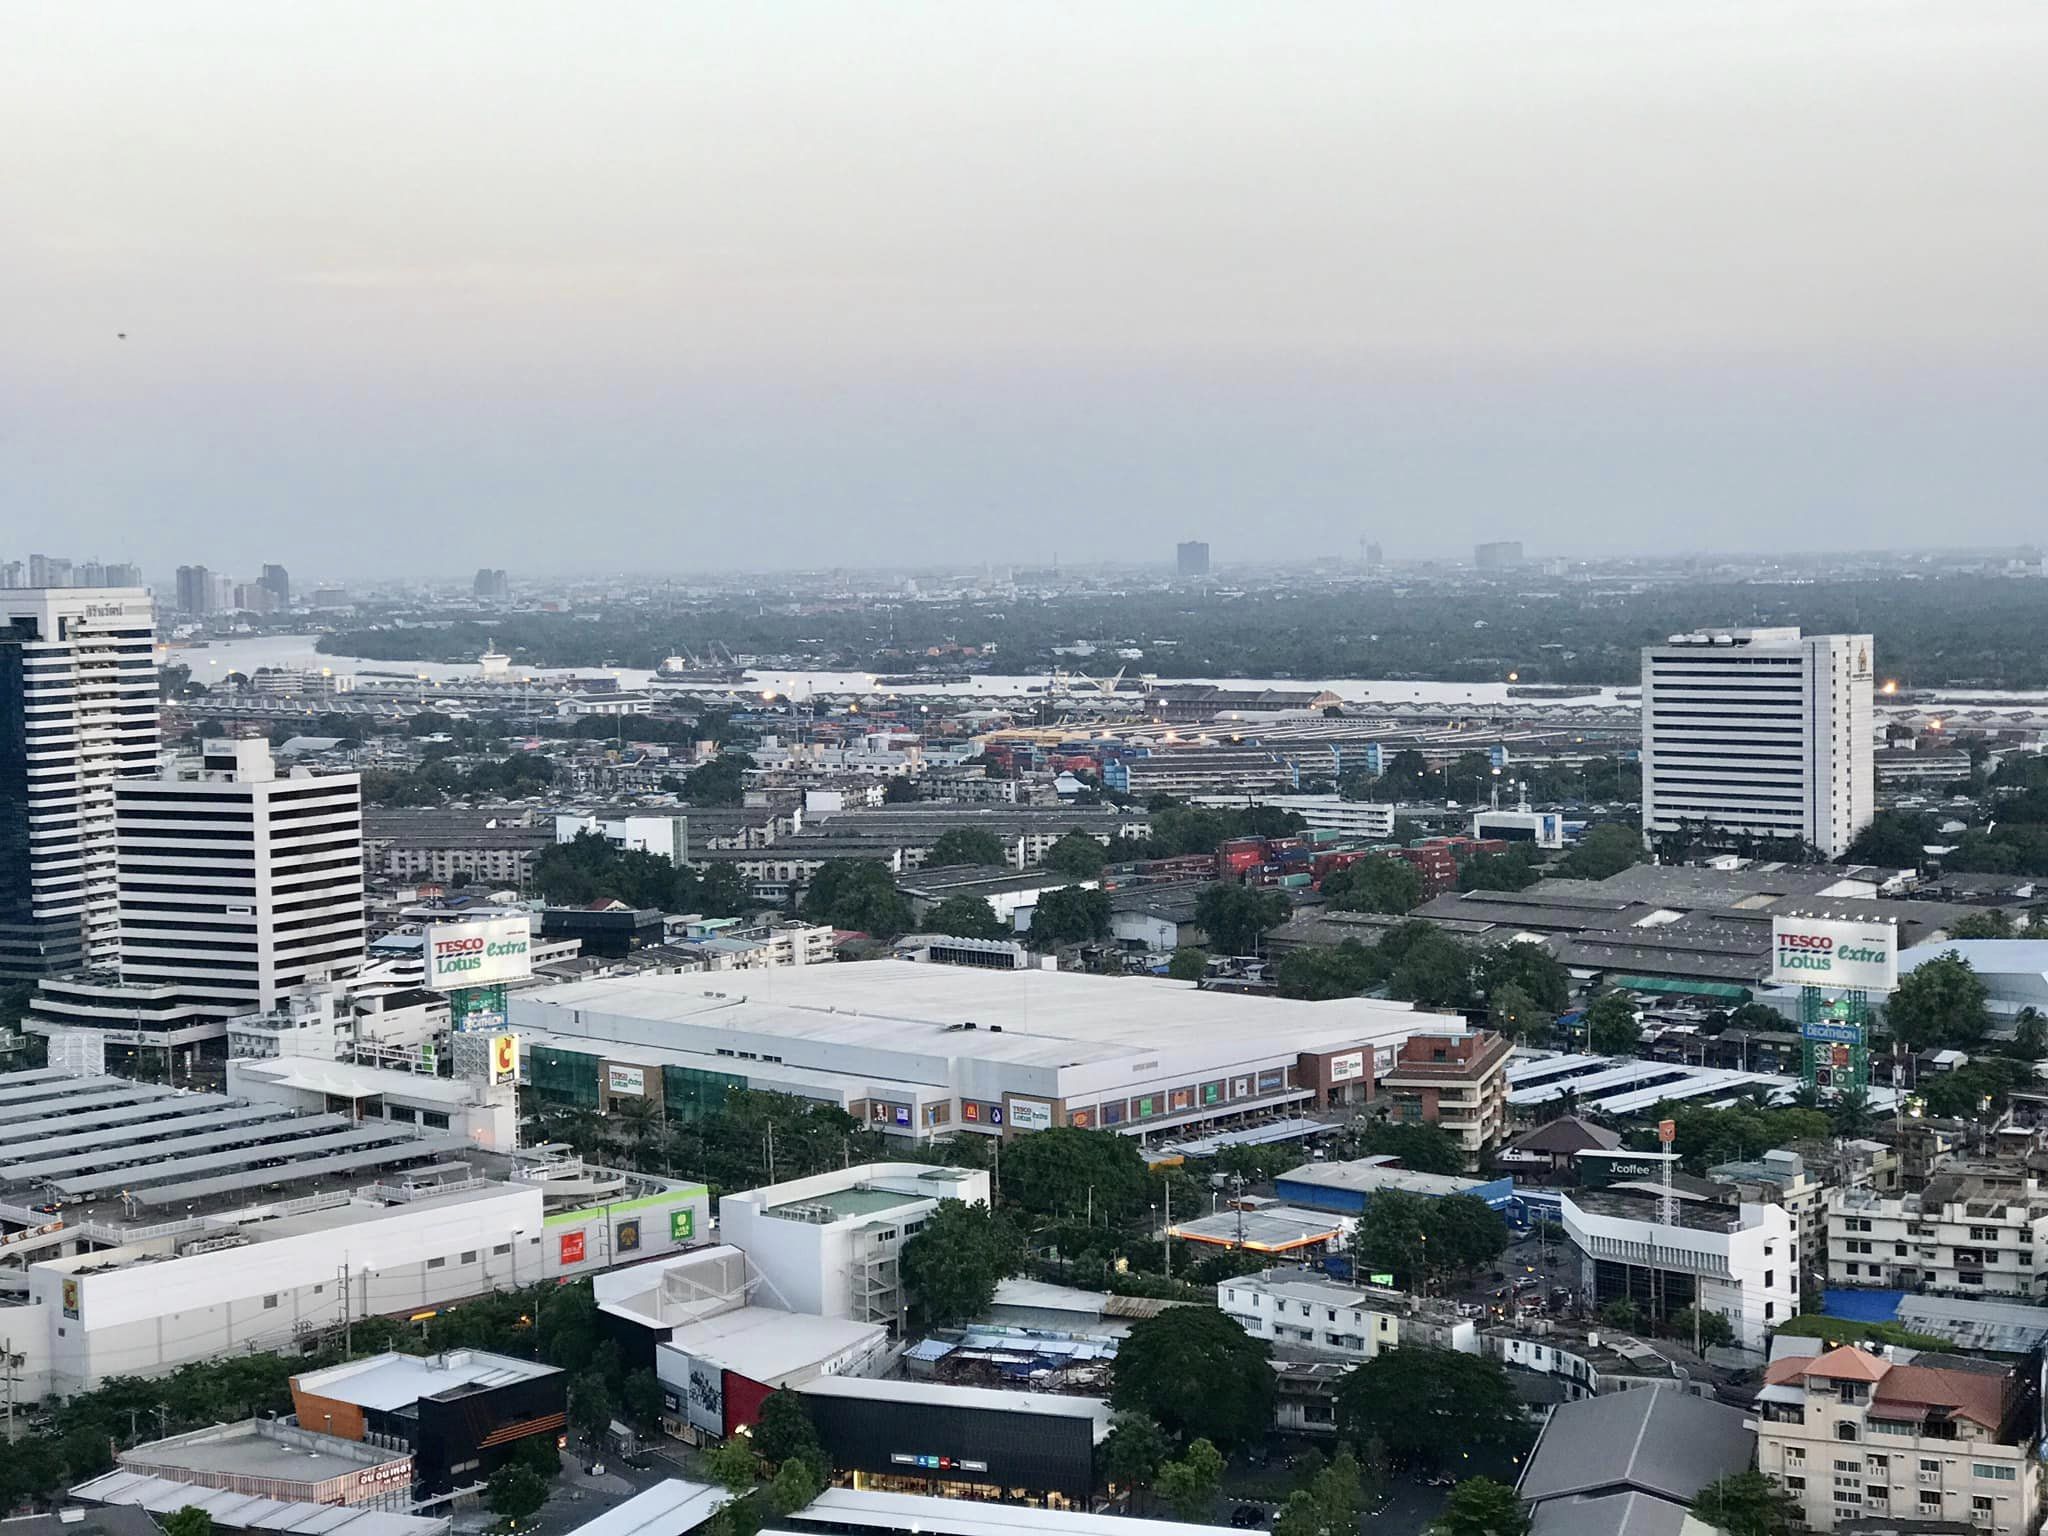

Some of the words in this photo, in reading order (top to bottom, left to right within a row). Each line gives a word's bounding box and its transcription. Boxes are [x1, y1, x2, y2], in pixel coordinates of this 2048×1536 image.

[434, 937, 484, 954] TESCO
[486, 941, 528, 957] extra
[1777, 933, 1833, 949] TESCO
[1780, 953, 1832, 971] Lotus
[1837, 945, 1886, 963] extra
[437, 957, 482, 974] Lotus
